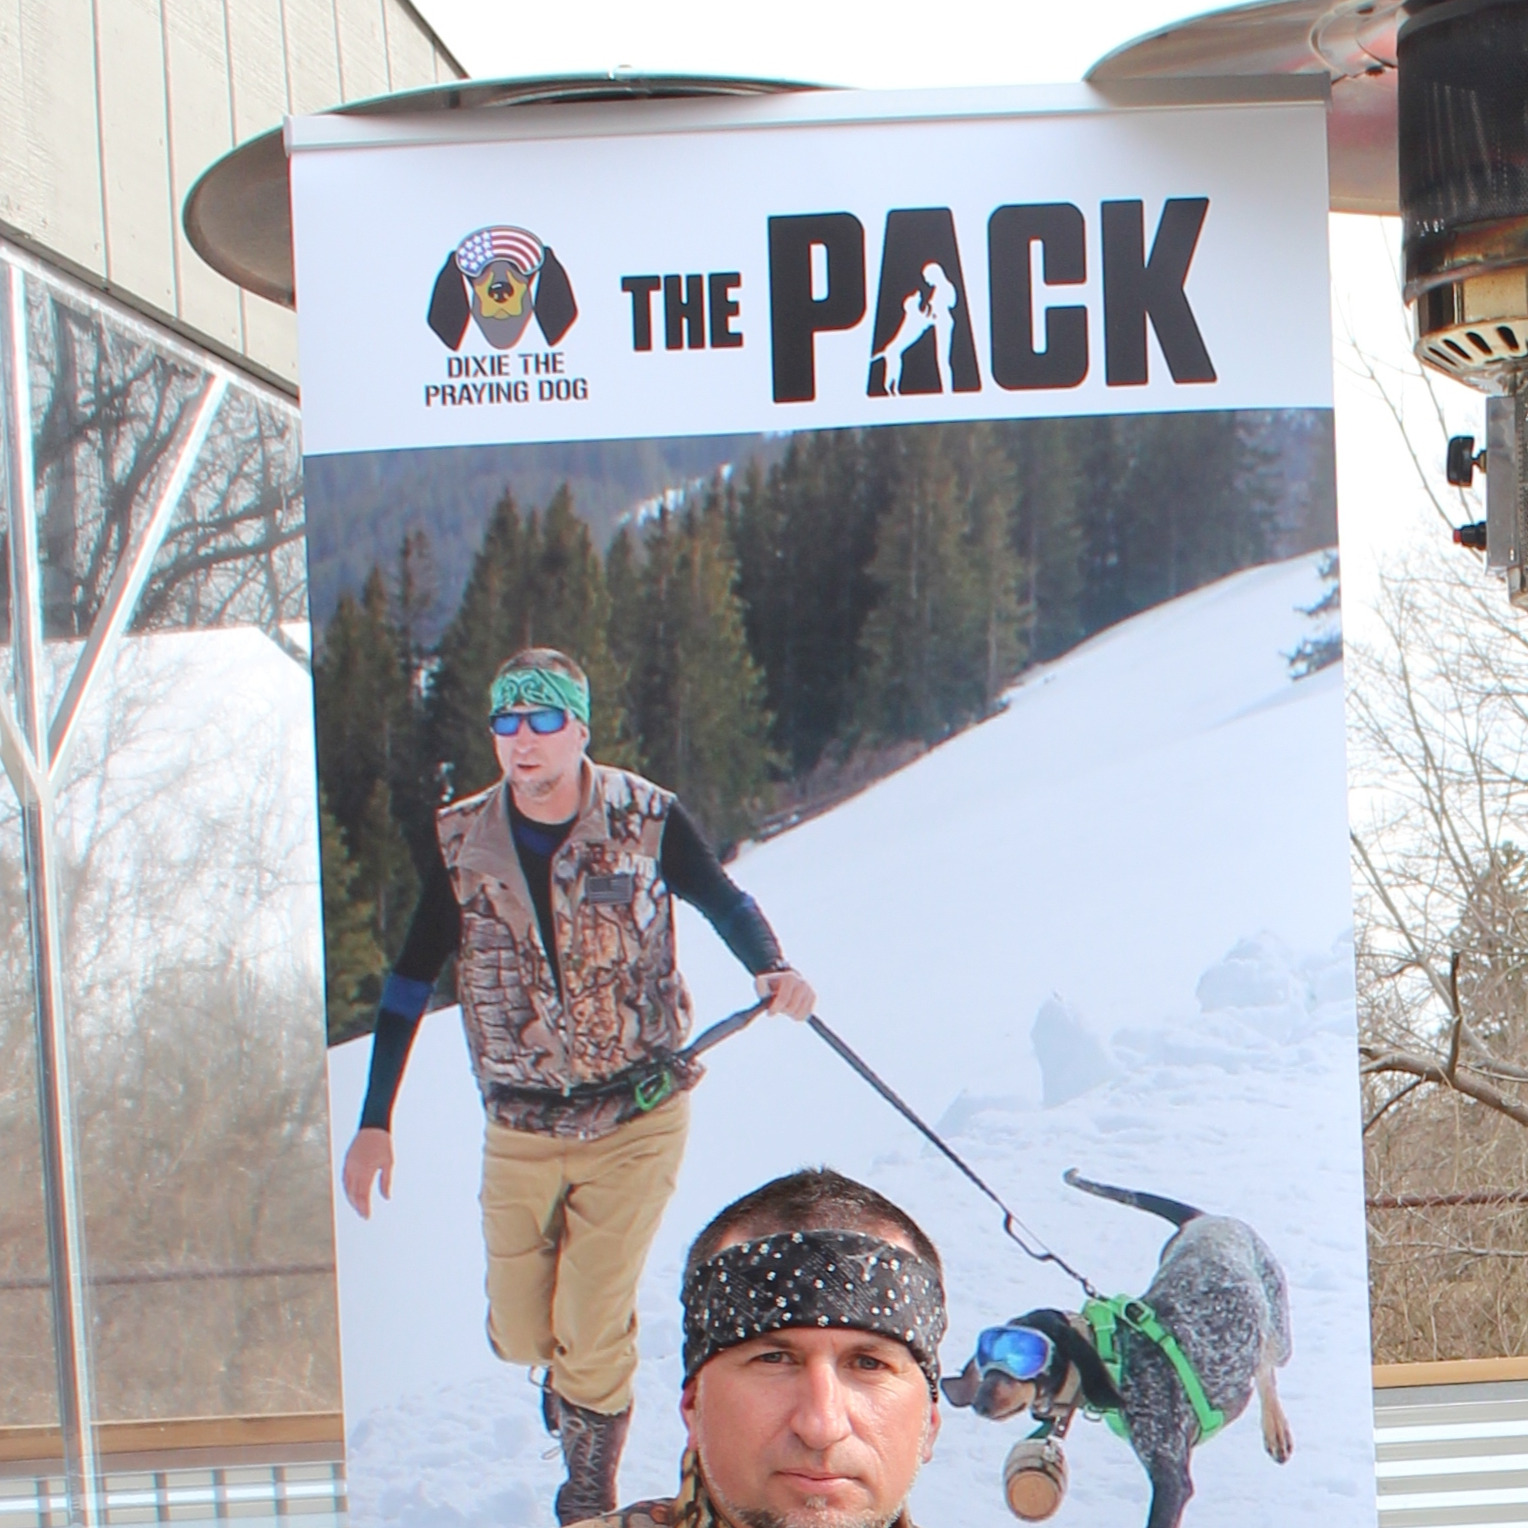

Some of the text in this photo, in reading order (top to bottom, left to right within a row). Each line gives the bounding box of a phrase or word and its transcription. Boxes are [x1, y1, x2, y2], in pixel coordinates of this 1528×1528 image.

[621, 196, 1218, 405] THE PACK
[447, 351, 565, 379] DIXIE THE
[424, 377, 589, 407] PRAYING DOG
